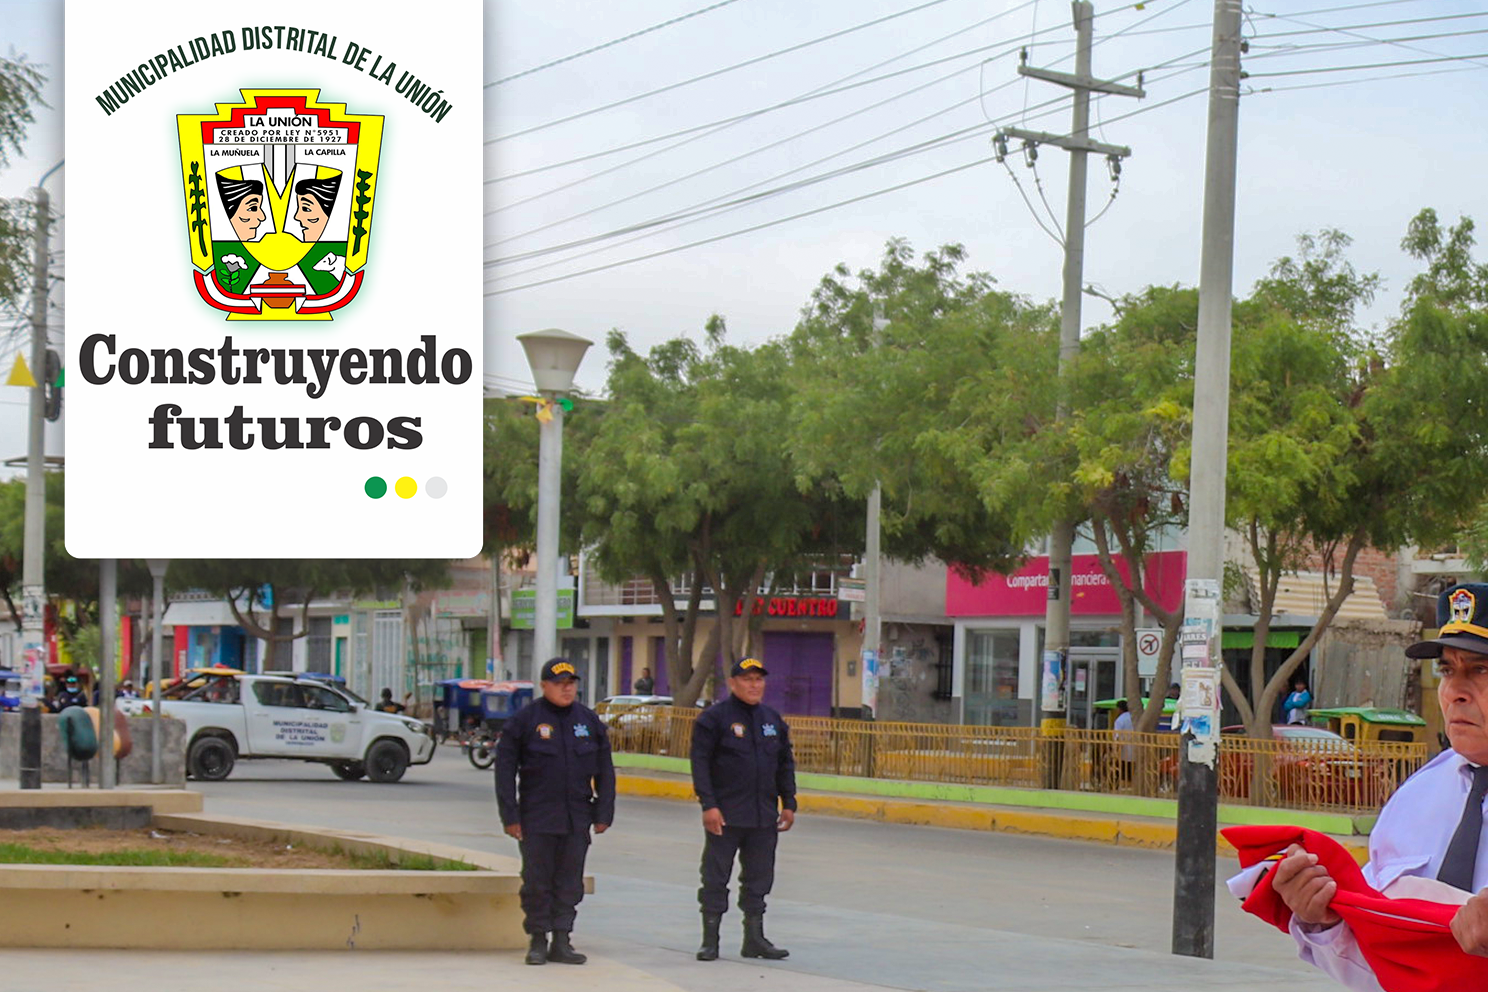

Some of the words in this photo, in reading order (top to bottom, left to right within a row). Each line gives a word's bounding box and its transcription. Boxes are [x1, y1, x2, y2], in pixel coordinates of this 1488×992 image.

[1006, 574, 1049, 591] Comparta
[1071, 571, 1107, 586] nanciera
[273, 720, 328, 728] MUNICIPALIDAD
